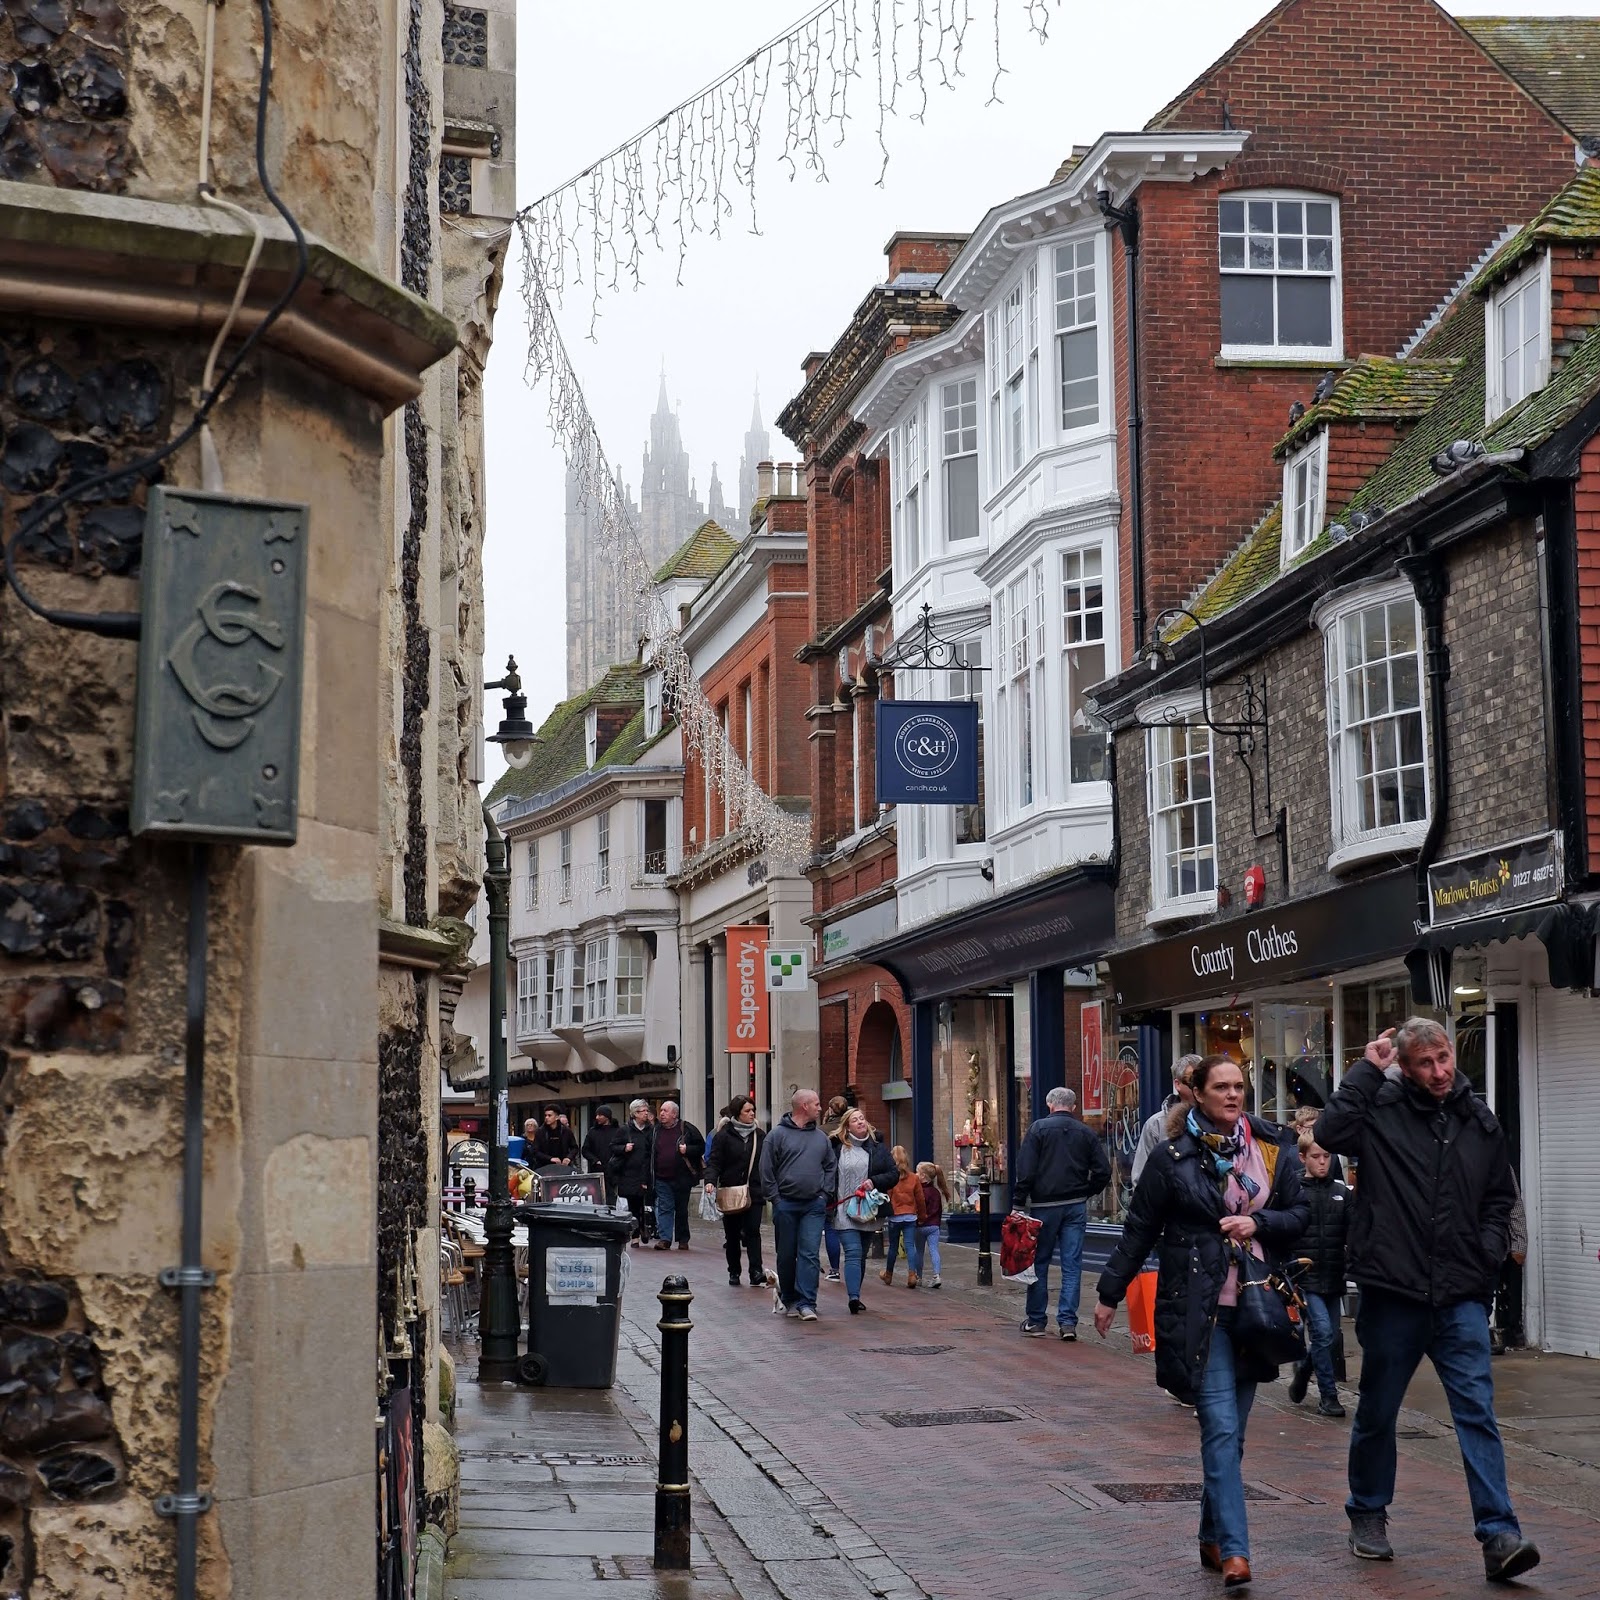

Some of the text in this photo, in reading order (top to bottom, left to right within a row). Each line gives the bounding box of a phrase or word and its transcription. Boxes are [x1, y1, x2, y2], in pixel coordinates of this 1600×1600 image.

[916, 717, 956, 742] HABERDASHERY
[907, 736, 947, 756] C&H
[911, 767, 929, 776] SINCE
[1434, 886, 1470, 907] Marlowe
[1469, 876, 1499, 898] Florists
[1513, 870, 1531, 888] 01227
[1191, 924, 1298, 980] County Clothes
[558, 1183, 588, 1197] City
[559, 1265, 593, 1273] FISH
[558, 1280, 595, 1288] CHIPS
